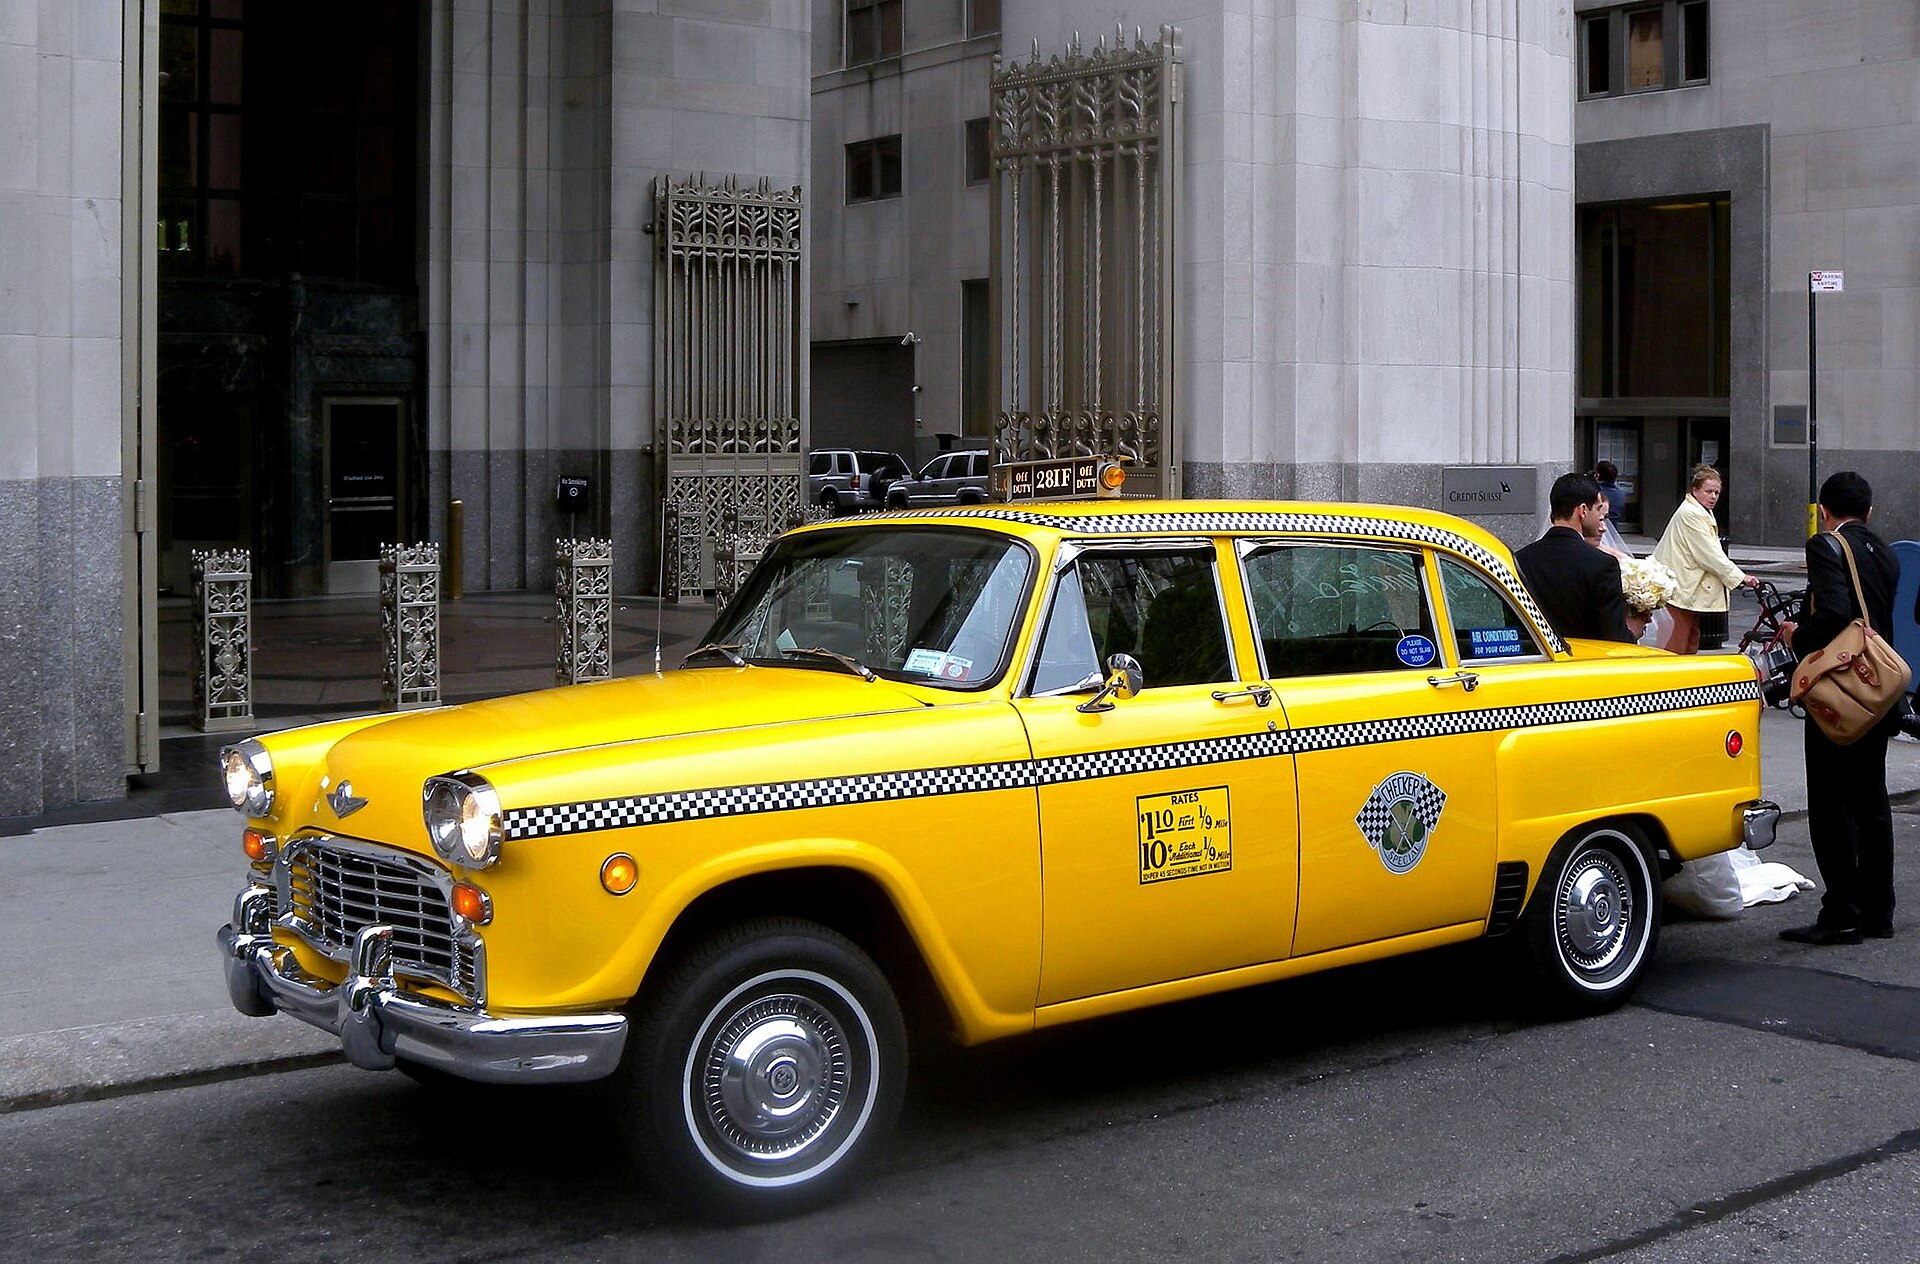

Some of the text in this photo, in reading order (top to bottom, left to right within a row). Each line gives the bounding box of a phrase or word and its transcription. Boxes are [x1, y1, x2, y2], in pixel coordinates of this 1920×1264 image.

[1013, 484, 1032, 494] DUTY
[1076, 478, 1097, 489] DUTY
[1449, 491, 1503, 502] CREDIT SUISSE
[1471, 629, 1519, 643] AIR CONDITIONED
[1400, 648, 1408, 656] DO
[1474, 646, 1484, 655] FOR
[1498, 644, 1521, 653] COMFORT
[1411, 655, 1425, 663] DOOR
[1380, 776, 1420, 804] CHECKER
[1171, 792, 1199, 806] RATES
[1178, 815, 1195, 827] First
[1180, 842, 1196, 852] Each
[1169, 850, 1203, 861] Additional
[1388, 846, 1420, 866] SPECIAL
